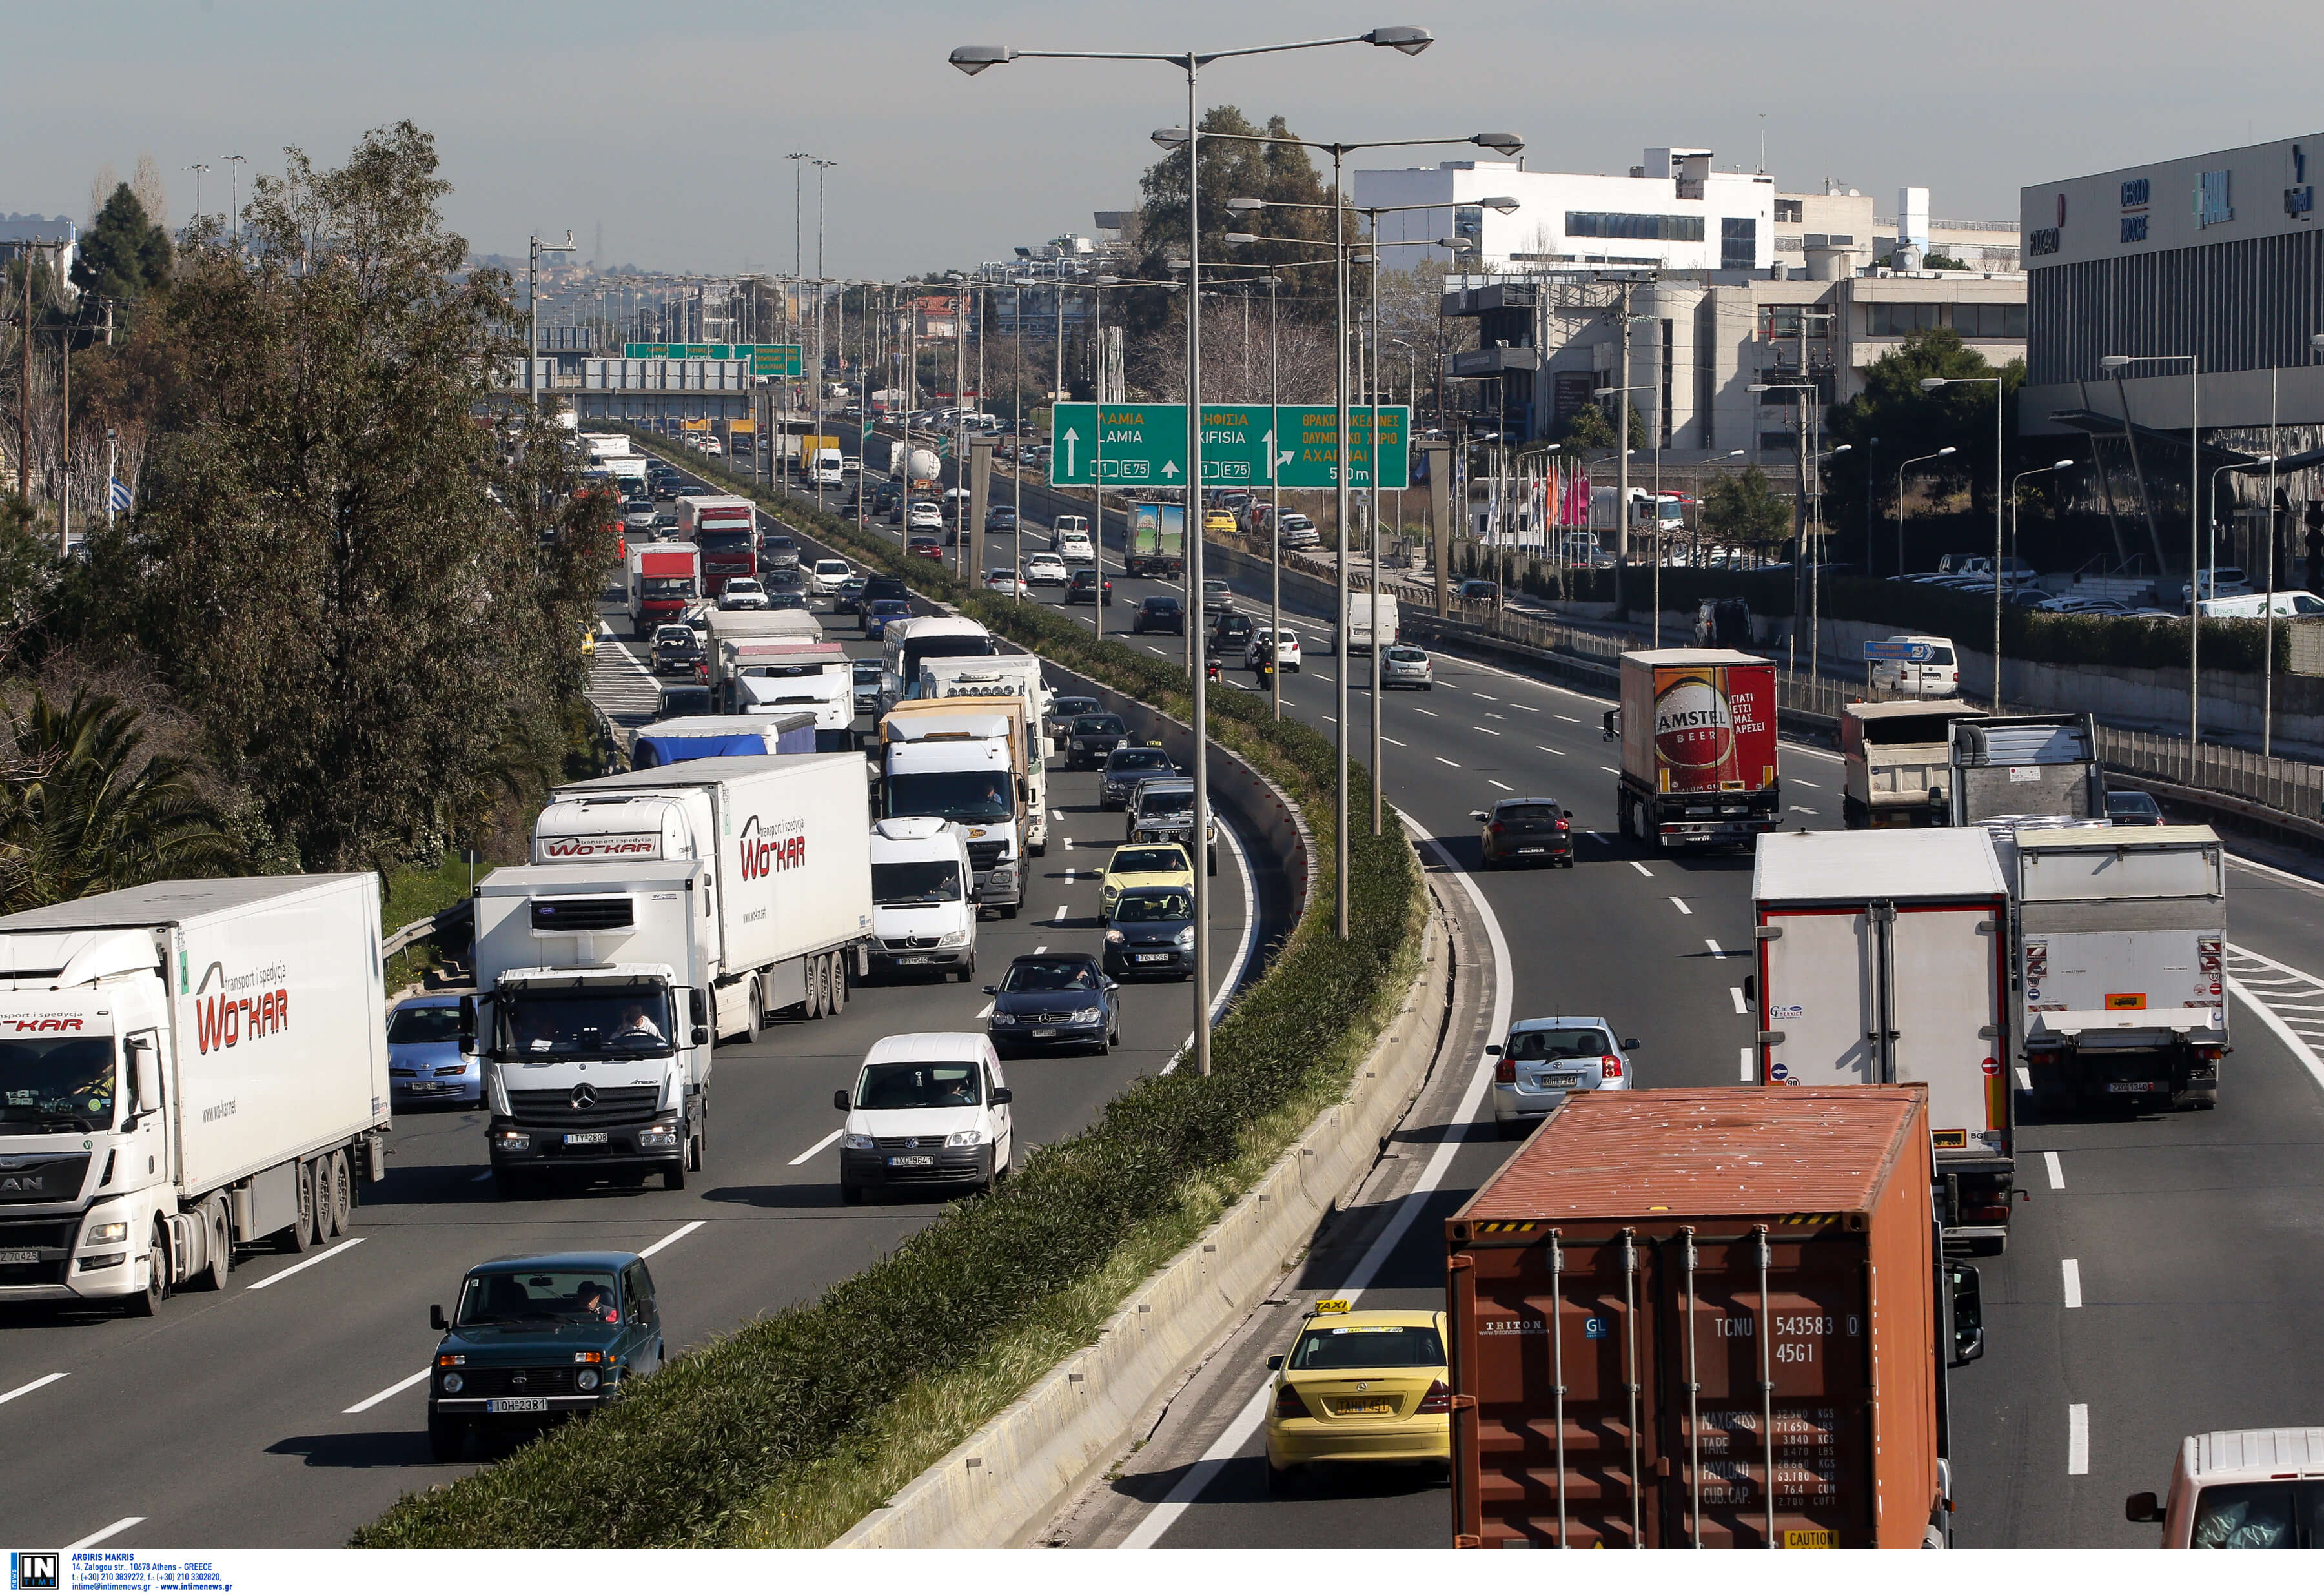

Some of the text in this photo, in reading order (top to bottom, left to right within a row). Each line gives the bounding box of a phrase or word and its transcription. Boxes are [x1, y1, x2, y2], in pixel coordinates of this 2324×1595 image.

[1200, 413, 1249, 426] ΗΦΙΣΙΑ
[1134, 463, 1147, 474] 75
[1234, 465, 1247, 475] 75
[1731, 693, 1754, 704] ΓΙΑΤΙ
[1733, 704, 1752, 715] ΕΤΣΙ
[1659, 711, 1726, 731] AMSTEL
[1735, 713, 1753, 724] ΜΑΣ
[1736, 722, 1766, 735] ΑΡΕΣΕΙ
[1677, 731, 1715, 743] BEER
[760, 820, 781, 838] transport
[785, 815, 804, 835] spedycja
[225, 970, 254, 994] transport
[260, 960, 286, 988] spedycja
[1316, 1301, 1347, 1310] TAXI
[1486, 1321, 1542, 1330] TRITON
[1585, 1319, 1606, 1332] GL
[1715, 1316, 1858, 1337] TCNU 543583 0
[1776, 1343, 1813, 1363] 45G1
[1776, 1408, 1834, 1419] 32.500 KGS
[1702, 1411, 1757, 1430] MAX GROSS
[1776, 1422, 1833, 1432] 71.650 LBS
[1782, 1434, 1834, 1445] 3.840 KGS
[1702, 1437, 1729, 1455] TARE
[1783, 1447, 1834, 1456] 8.470 LBS
[1819, 1459, 1835, 1468] KGS
[1703, 1461, 1749, 1480] PAYLOAD
[1777, 1472, 1834, 1481] 63.180 LBS
[1784, 1484, 1835, 1494] 76.4 CUM
[1704, 1487, 1751, 1504] CUB. CAP.
[1790, 1532, 1833, 1546] CAUTION
